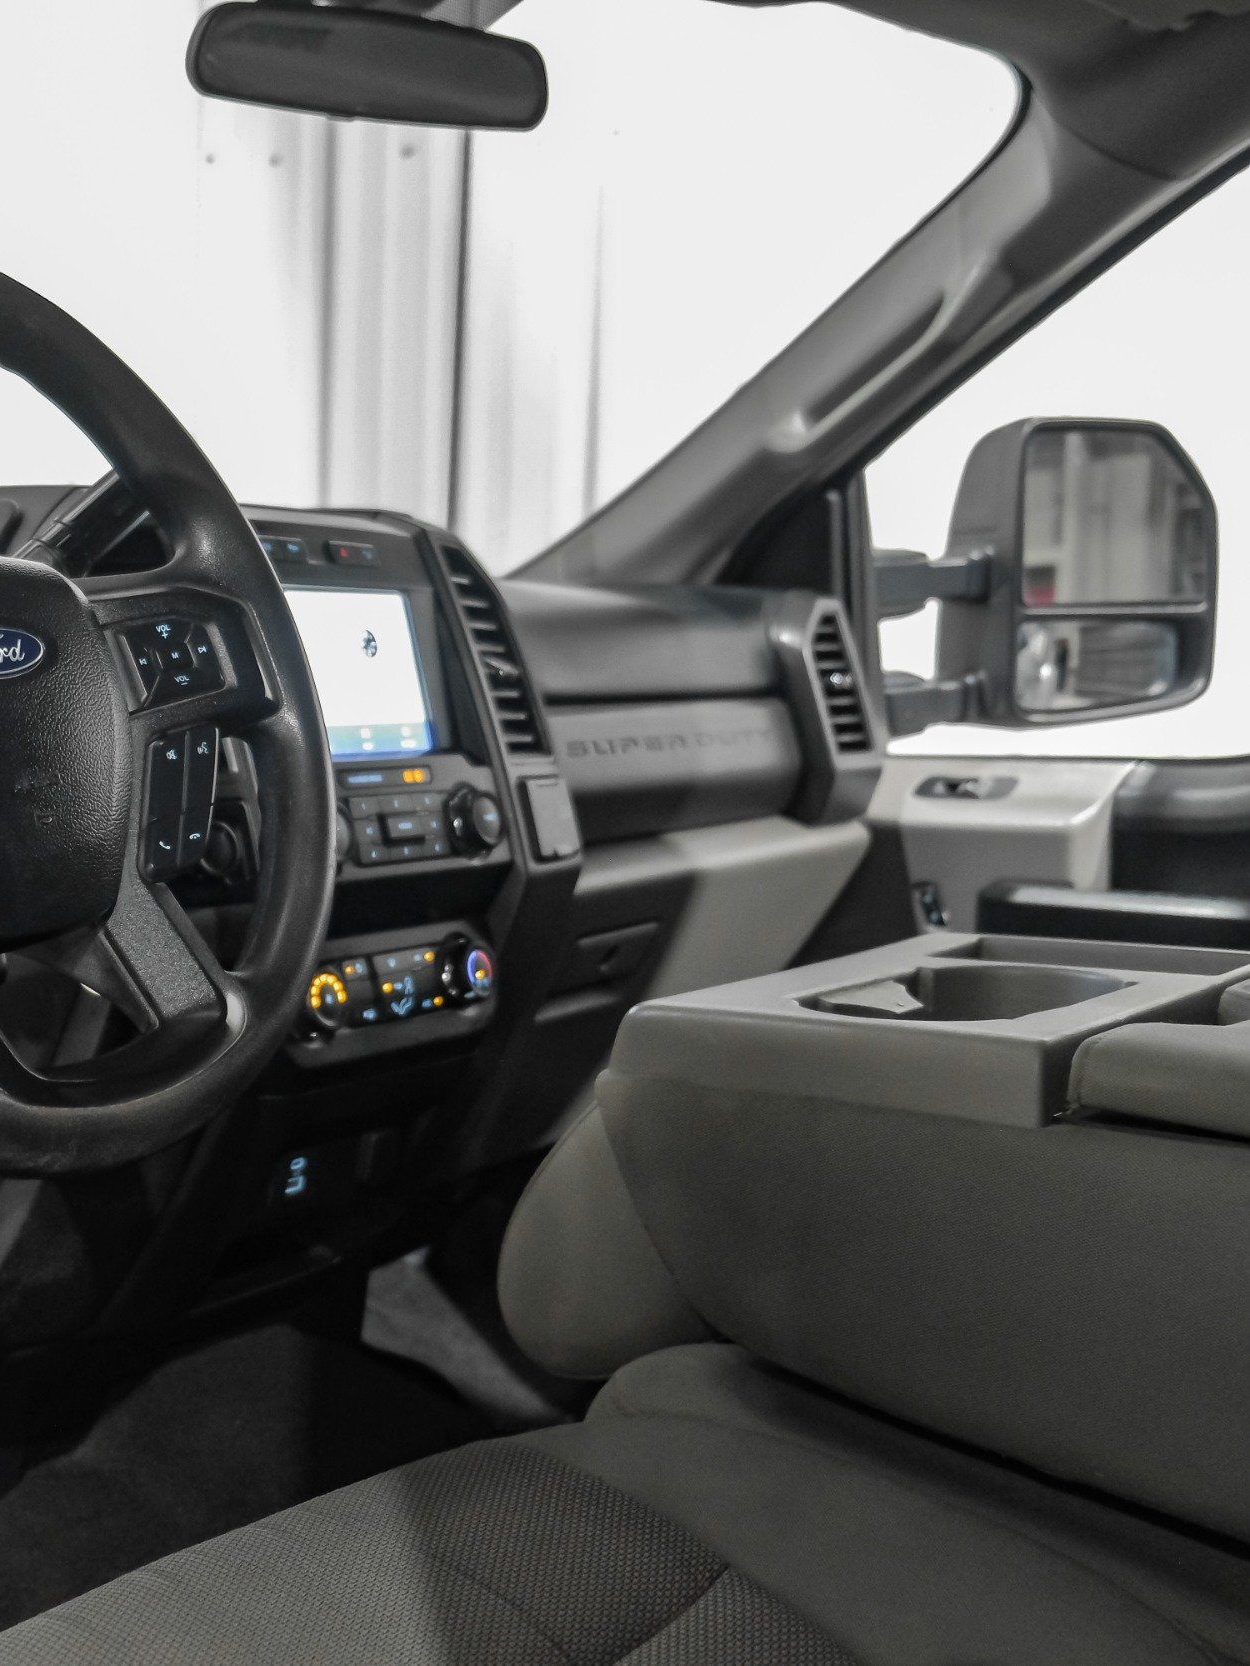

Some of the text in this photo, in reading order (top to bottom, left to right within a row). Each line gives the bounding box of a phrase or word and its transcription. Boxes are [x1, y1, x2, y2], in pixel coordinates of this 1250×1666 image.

[155, 624, 171, 633] VOL
[174, 675, 190, 683] VOL
[565, 735, 689, 758] SUPER
